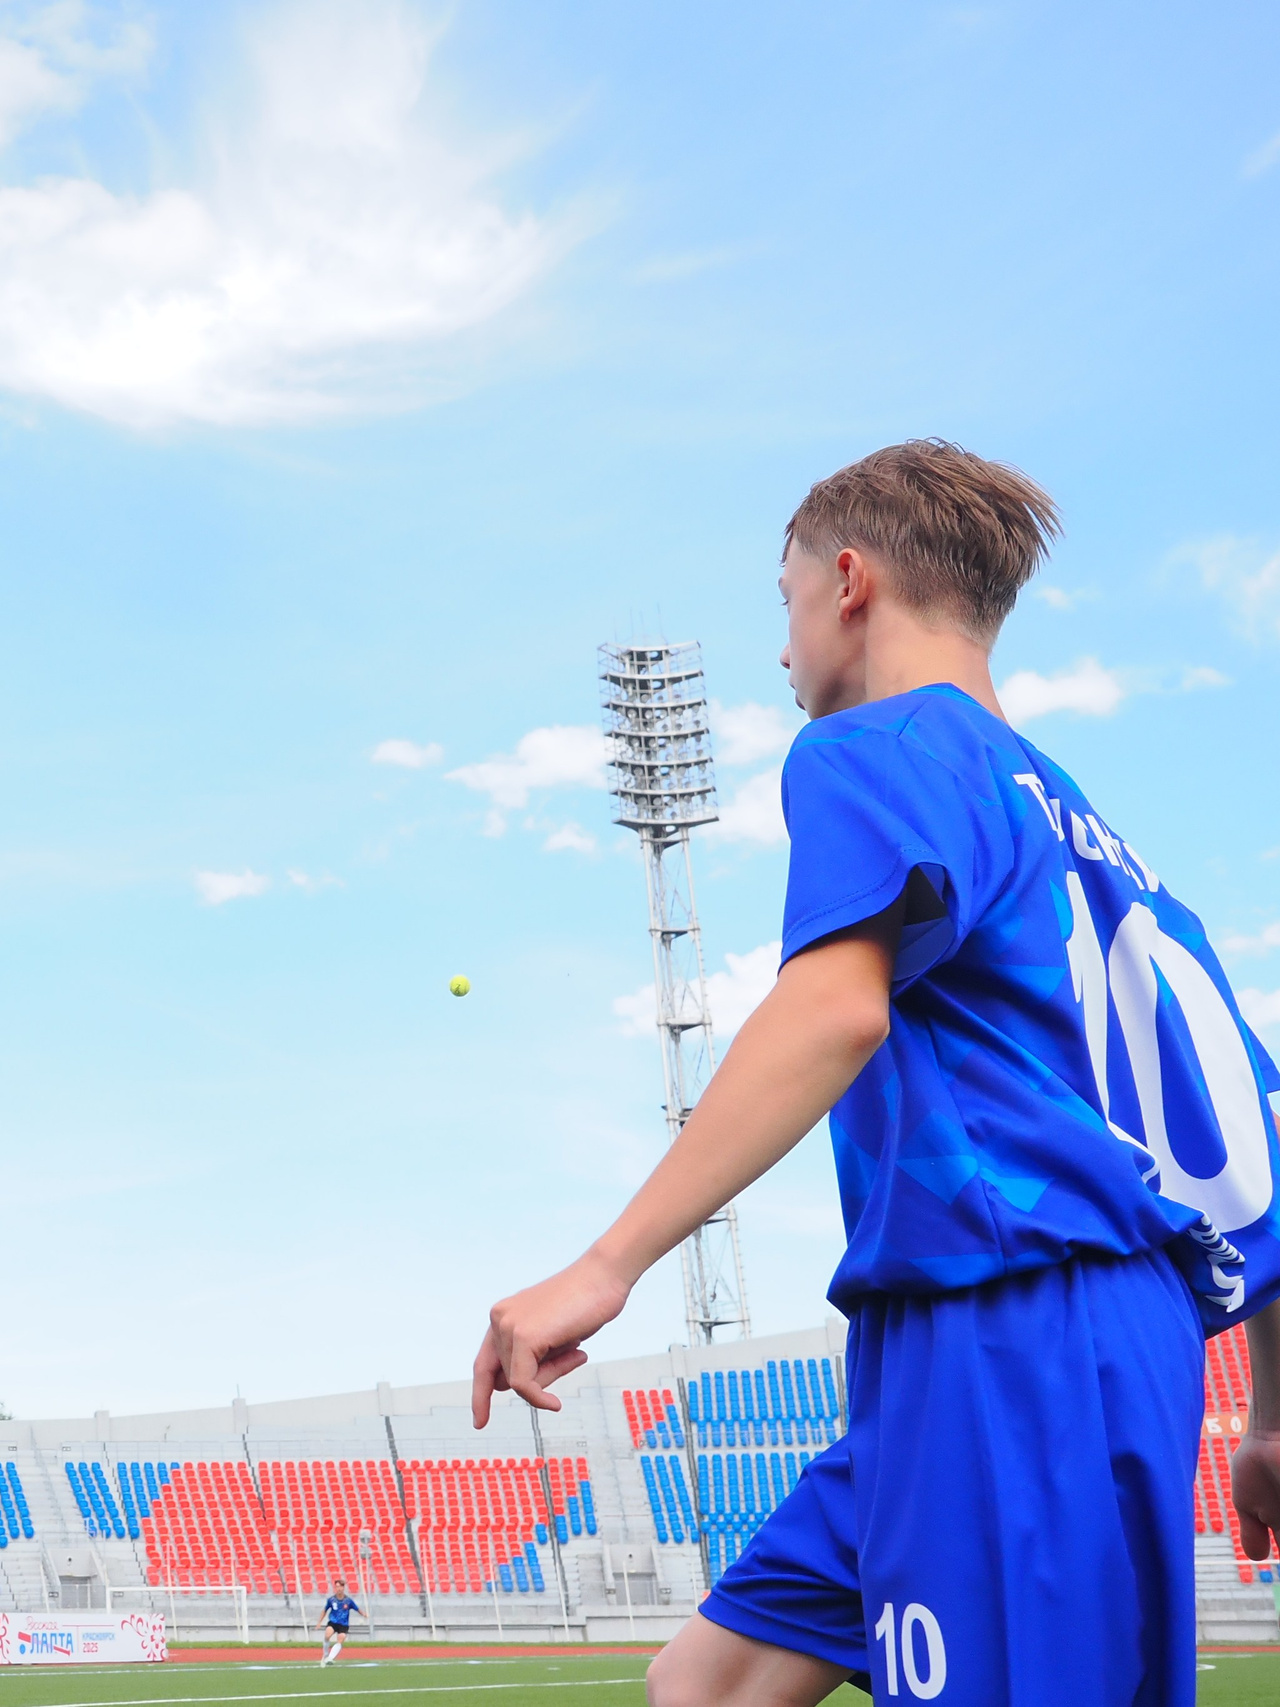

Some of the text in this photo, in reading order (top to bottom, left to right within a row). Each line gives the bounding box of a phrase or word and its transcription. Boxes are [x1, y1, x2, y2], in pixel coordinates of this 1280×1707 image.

[1065, 870, 1274, 1233] 10
[30, 1632, 74, 1654] ЛАПТА
[82, 1642, 98, 1653] 2025
[874, 1602, 948, 1700] 10
